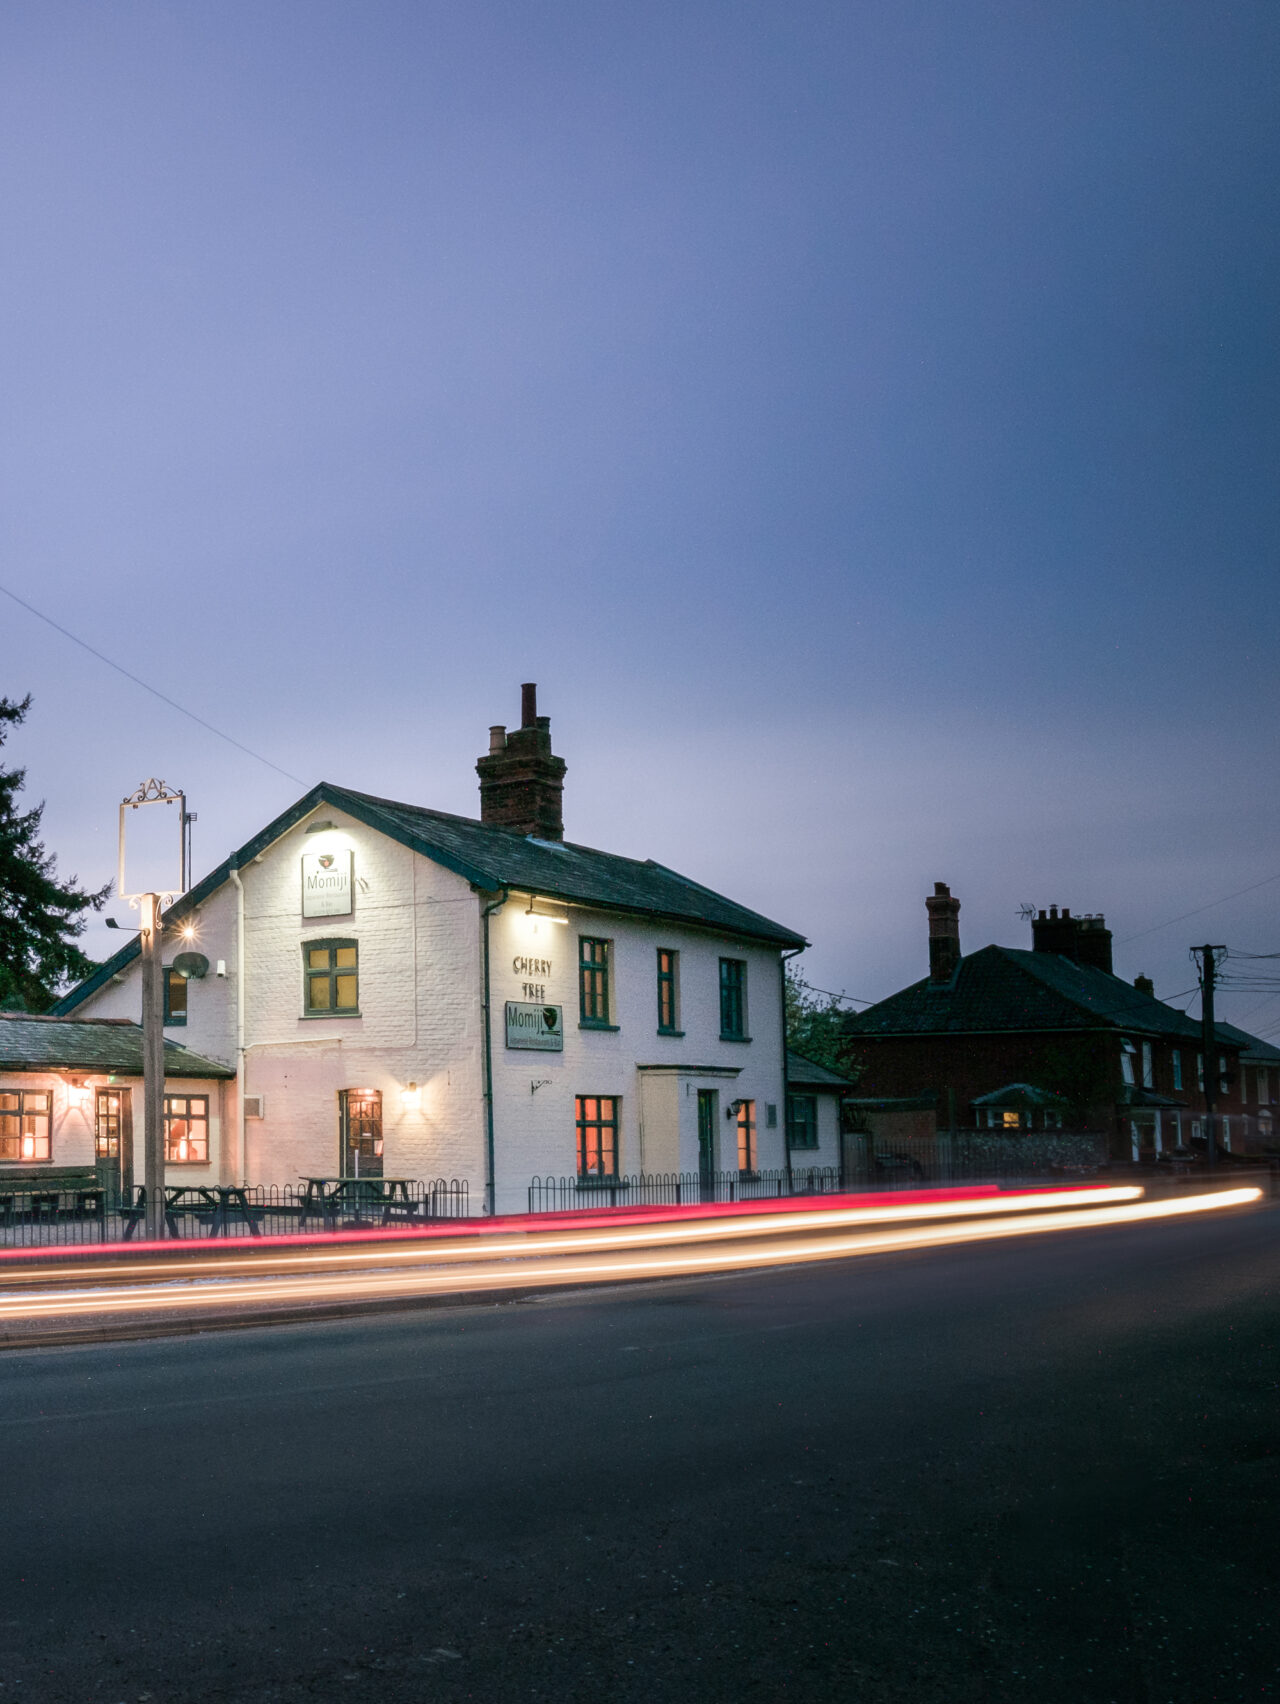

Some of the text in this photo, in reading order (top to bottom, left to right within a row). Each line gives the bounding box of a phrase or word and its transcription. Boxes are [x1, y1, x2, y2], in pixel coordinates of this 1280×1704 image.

[307, 872, 347, 891] Momiji
[513, 956, 552, 977] CHERRY
[523, 983, 546, 999] TREE
[508, 1006, 543, 1034] Momiji
